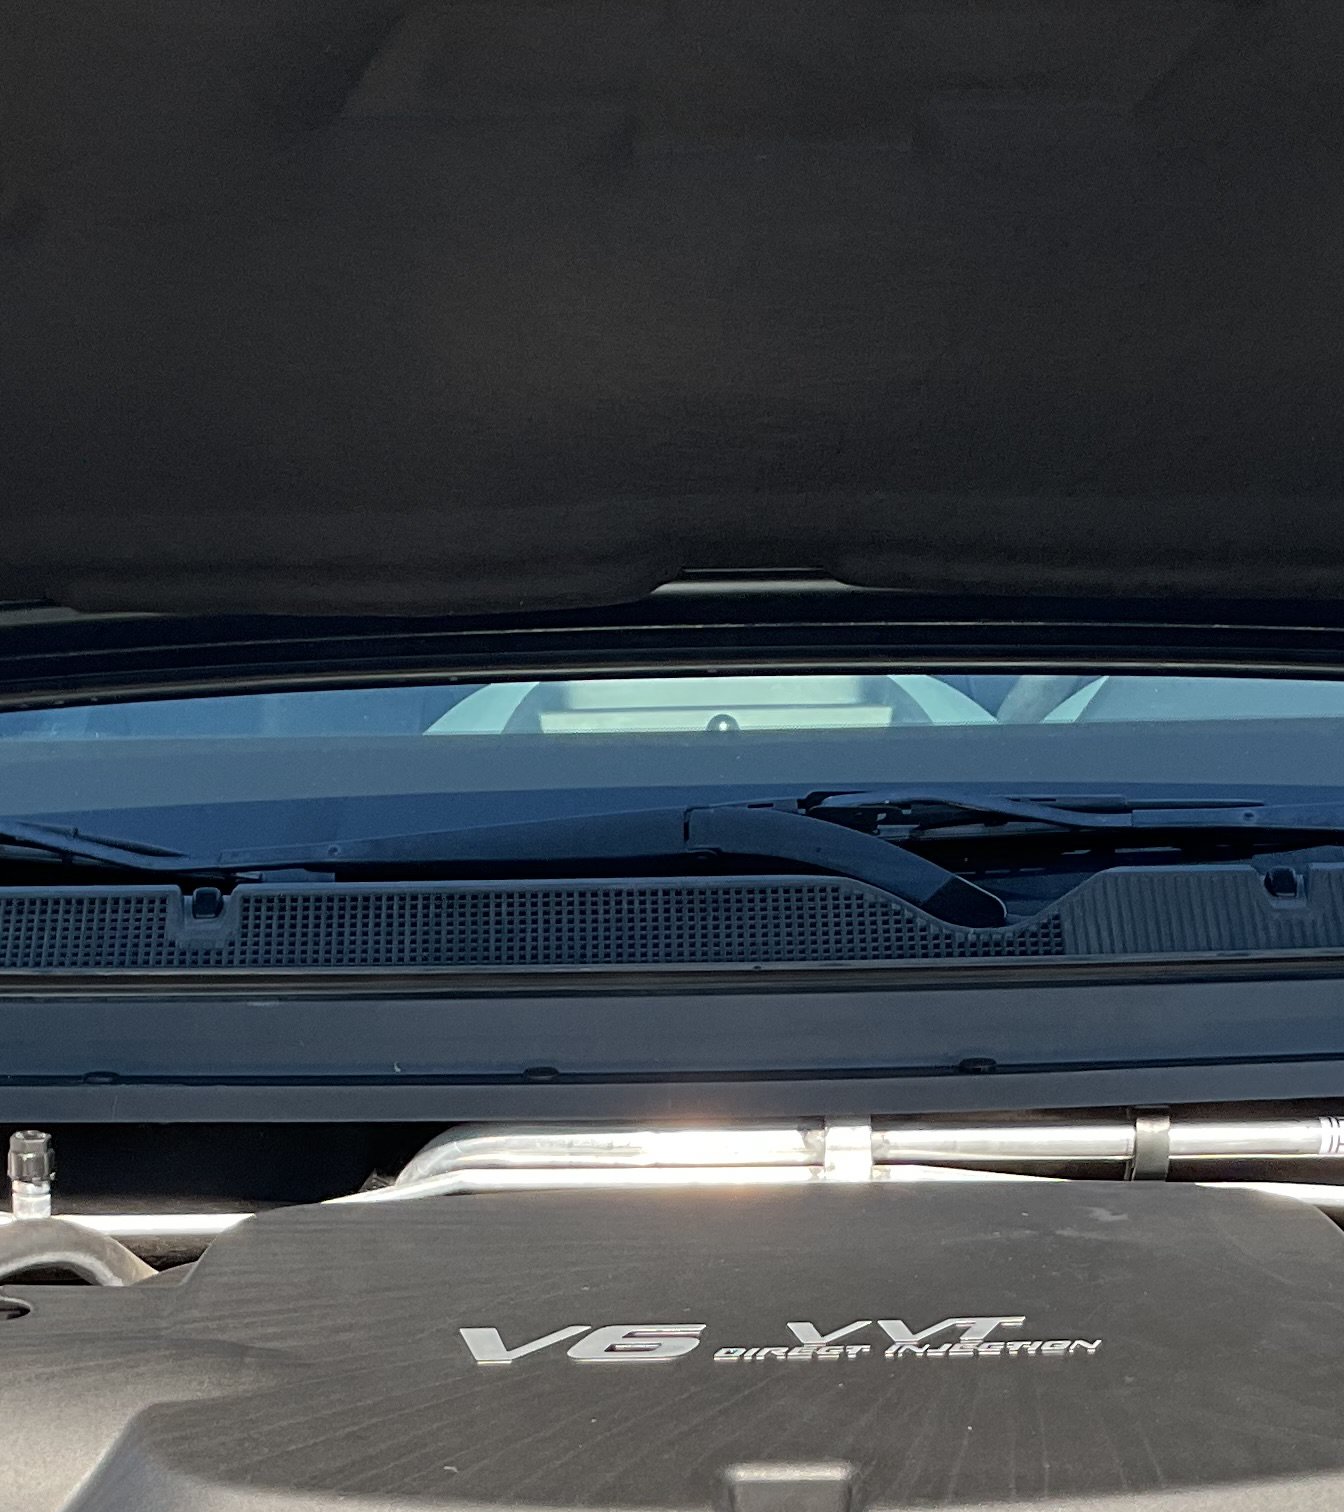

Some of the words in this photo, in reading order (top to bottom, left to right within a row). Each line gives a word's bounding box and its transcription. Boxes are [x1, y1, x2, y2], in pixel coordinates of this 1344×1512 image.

[459, 1323, 707, 1364] V6
[786, 1315, 1026, 1344] VVT
[713, 1344, 872, 1361] DIRECT
[884, 1339, 1103, 1358] INJECTION
